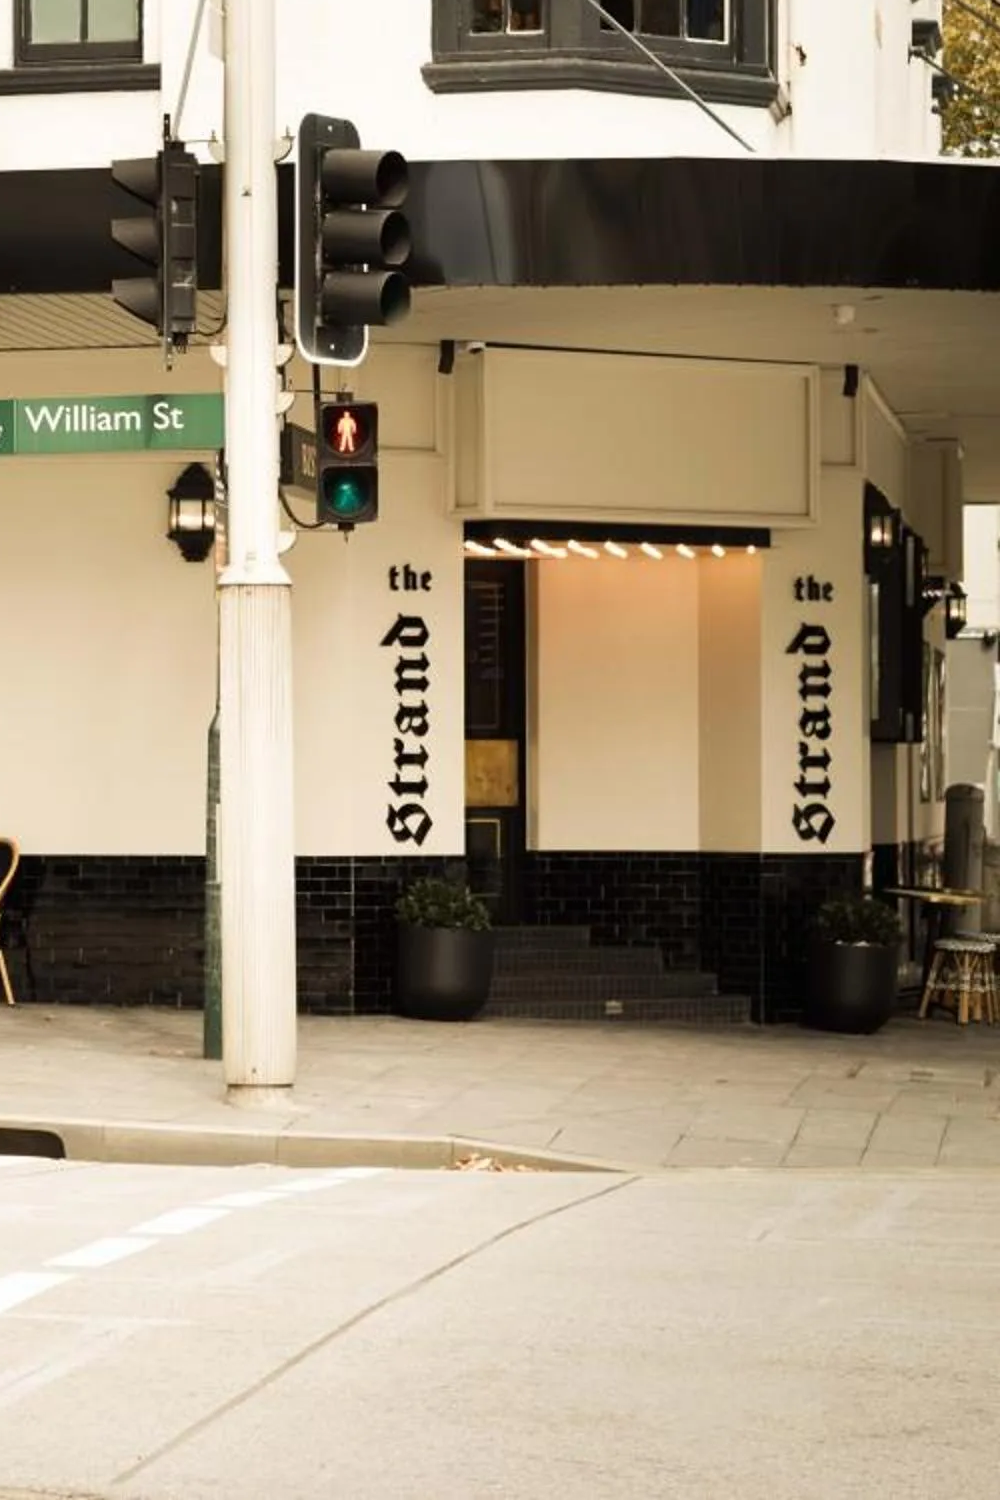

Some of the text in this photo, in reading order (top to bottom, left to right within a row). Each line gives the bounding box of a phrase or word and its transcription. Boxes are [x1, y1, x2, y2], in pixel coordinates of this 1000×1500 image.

[24, 402, 185, 433] William St
[388, 563, 433, 592] the
[793, 573, 835, 602] the
[380, 613, 433, 847] Strand
[785, 621, 836, 845] Strand
